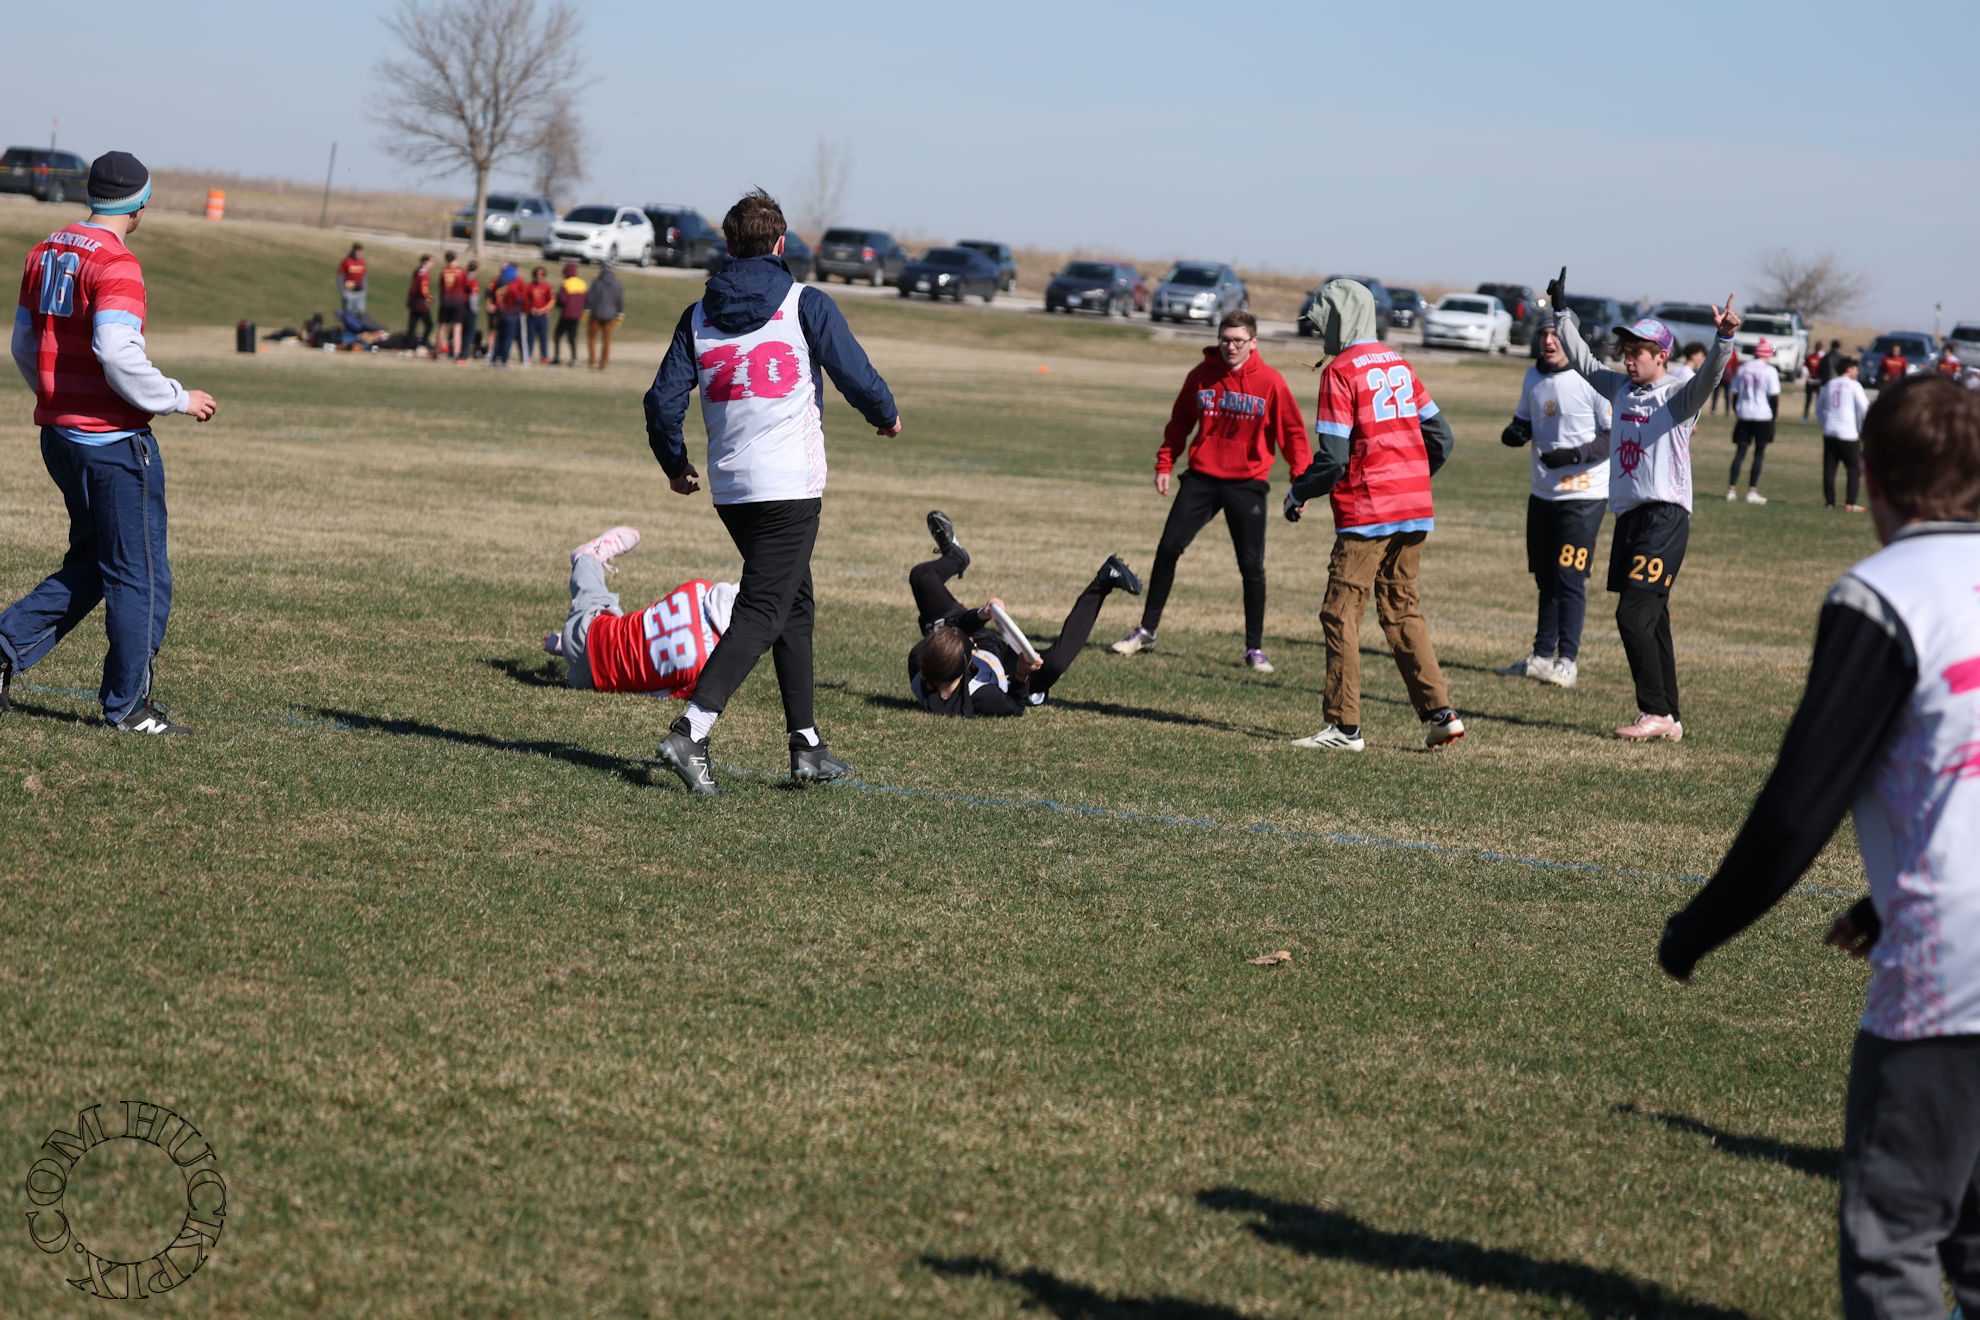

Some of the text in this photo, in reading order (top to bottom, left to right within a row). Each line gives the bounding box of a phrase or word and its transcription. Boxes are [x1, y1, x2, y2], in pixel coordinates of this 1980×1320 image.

[40, 249, 80, 317] 16
[1219, 390, 1266, 416] JOHN'S
[1366, 365, 1418, 423] 22
[1561, 472, 1591, 492] 88
[1559, 544, 1589, 571] 88
[1628, 555, 1664, 583] 29
[643, 591, 698, 677] 28
